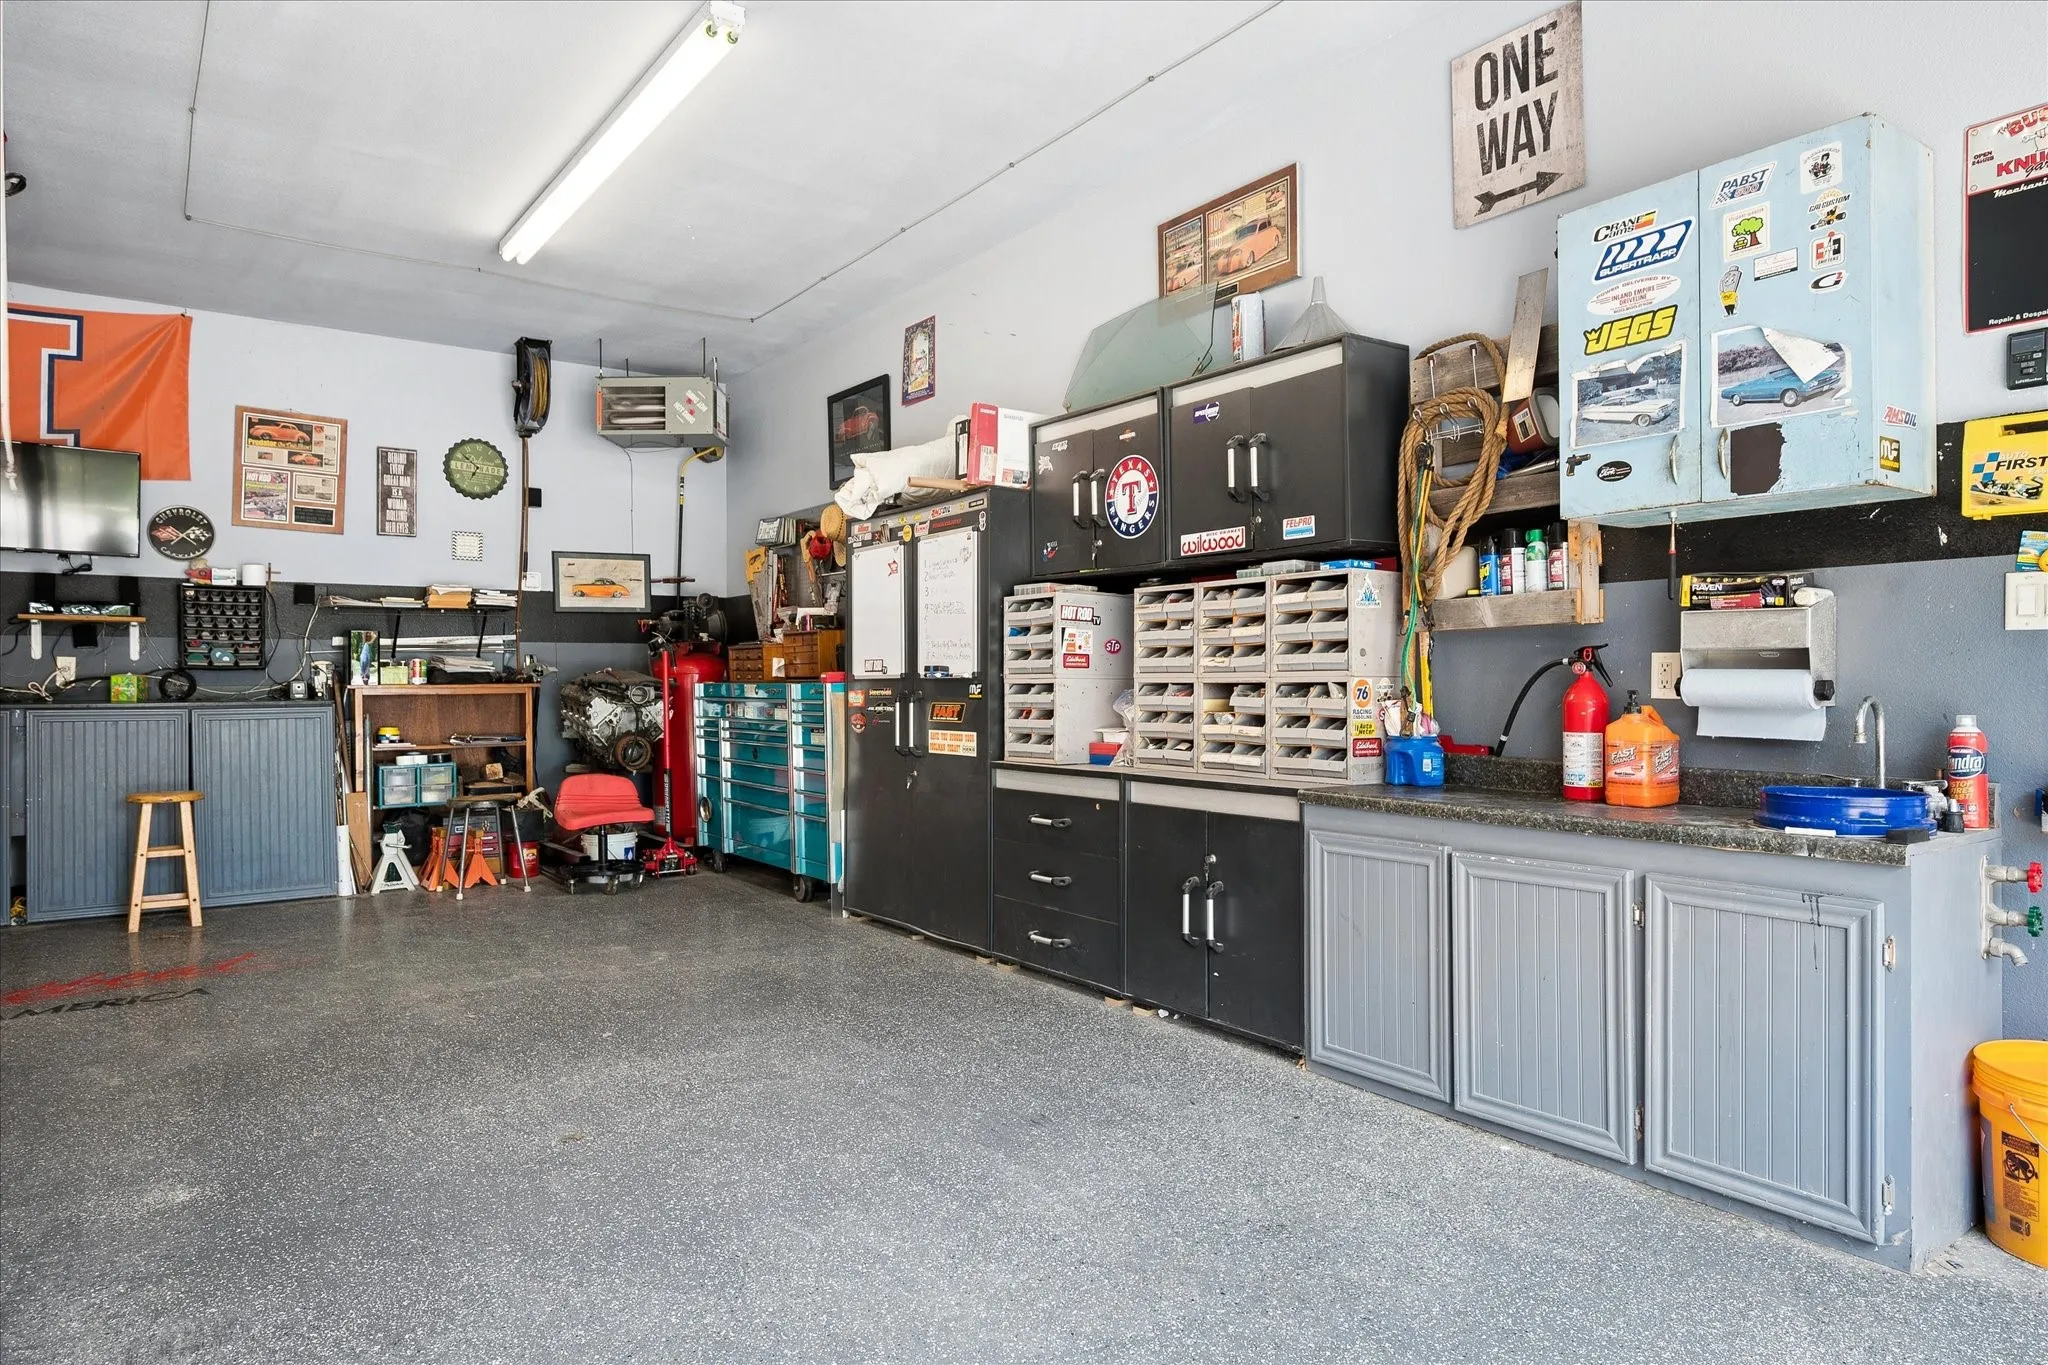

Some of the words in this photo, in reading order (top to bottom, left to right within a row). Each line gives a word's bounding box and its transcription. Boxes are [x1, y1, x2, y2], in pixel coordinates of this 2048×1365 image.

[1474, 20, 1558, 111] ONE
[1476, 90, 1558, 176] WAY
[1973, 151, 1992, 160] OPEN
[1721, 169, 1769, 192] PABST
[1821, 194, 1850, 209] CUSTOM
[1594, 214, 1644, 242] CRANE
[1595, 285, 1620, 300] POWER
[1621, 276, 1658, 287] DELIVERED
[1611, 291, 1633, 302] INLAND
[1633, 285, 1655, 295] EMPIRE
[1619, 293, 1647, 306] DRIVELINE
[1988, 316, 2014, 326] Repair
[1584, 305, 1678, 355] JEGS
[1884, 406, 1917, 427] AMSOIL
[1112, 460, 1151, 483] TEXAS
[1995, 456, 2048, 471] FIRST
[1122, 480, 1142, 516] T
[155, 508, 208, 525] CHEVROLET
[1109, 500, 1156, 534] RANGERS
[1286, 517, 1312, 529] FEL-PRO
[1182, 528, 1244, 555] wilwood
[1062, 606, 1077, 620] HOT
[1077, 607, 1093, 621] ROD
[1093, 616, 1101, 625] TV
[1106, 640, 1120, 652] STP
[1356, 686, 1369, 700] 76
[1356, 741, 1378, 749] Edelbrock
[1611, 746, 1637, 760] FAST
[1611, 755, 1637, 766] ORANGE
[1655, 746, 1673, 764] FAST
